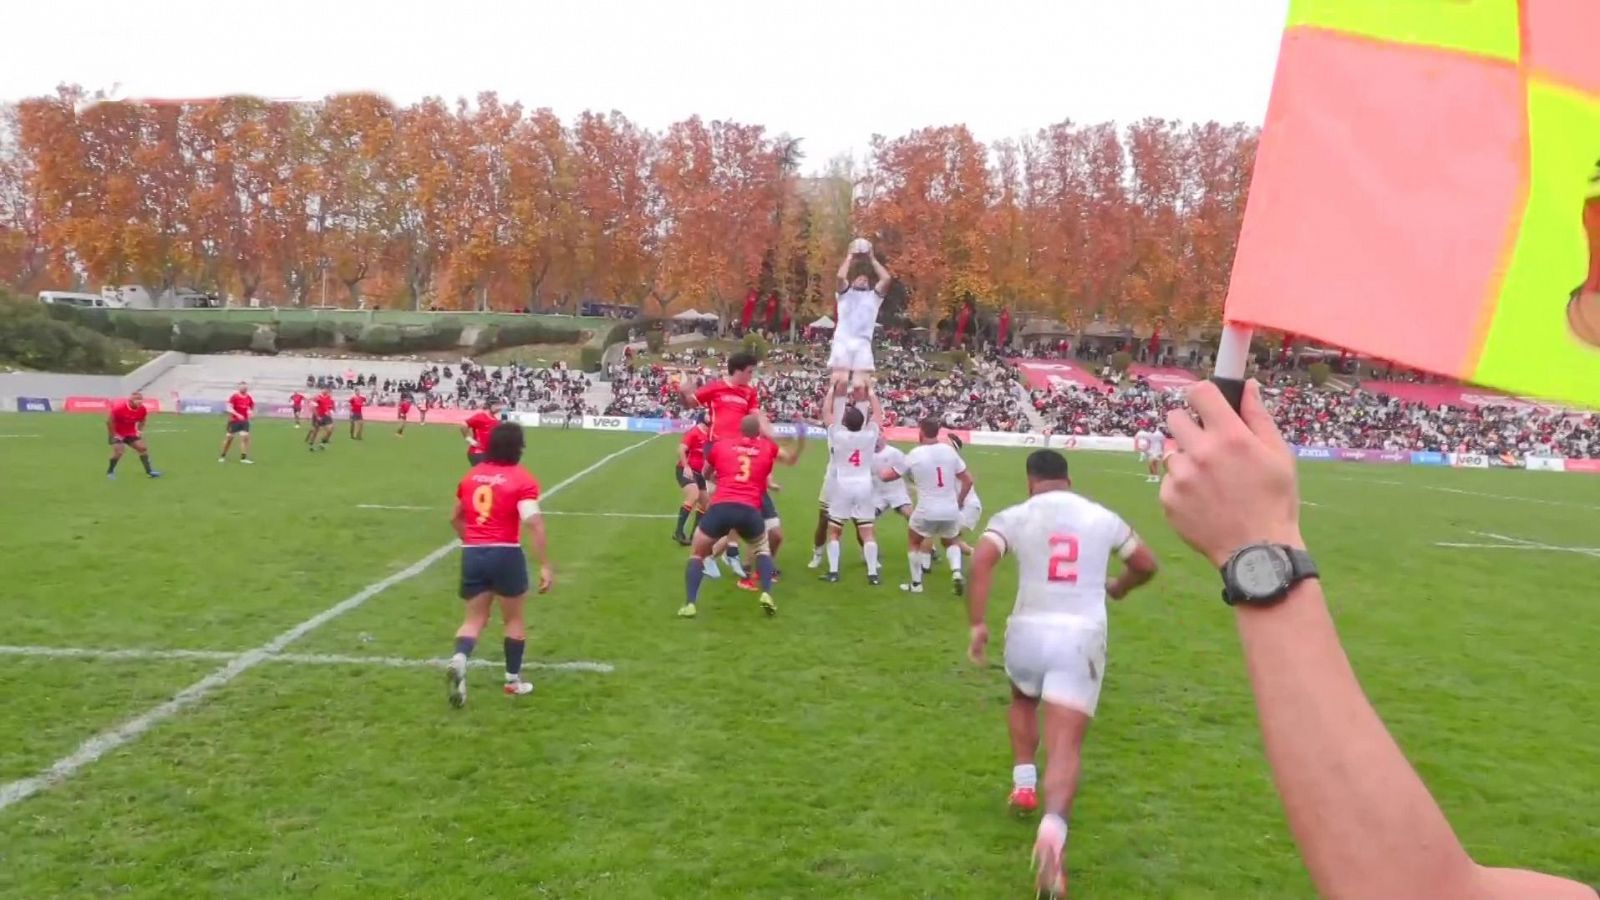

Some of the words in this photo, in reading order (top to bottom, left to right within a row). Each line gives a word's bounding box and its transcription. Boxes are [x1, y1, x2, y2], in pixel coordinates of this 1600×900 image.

[593, 417, 621, 428] veo
[735, 455, 751, 482] 3
[848, 449, 861, 467] 4
[936, 466, 944, 488] 1
[472, 484, 493, 525] 9
[1047, 534, 1079, 583] 2
